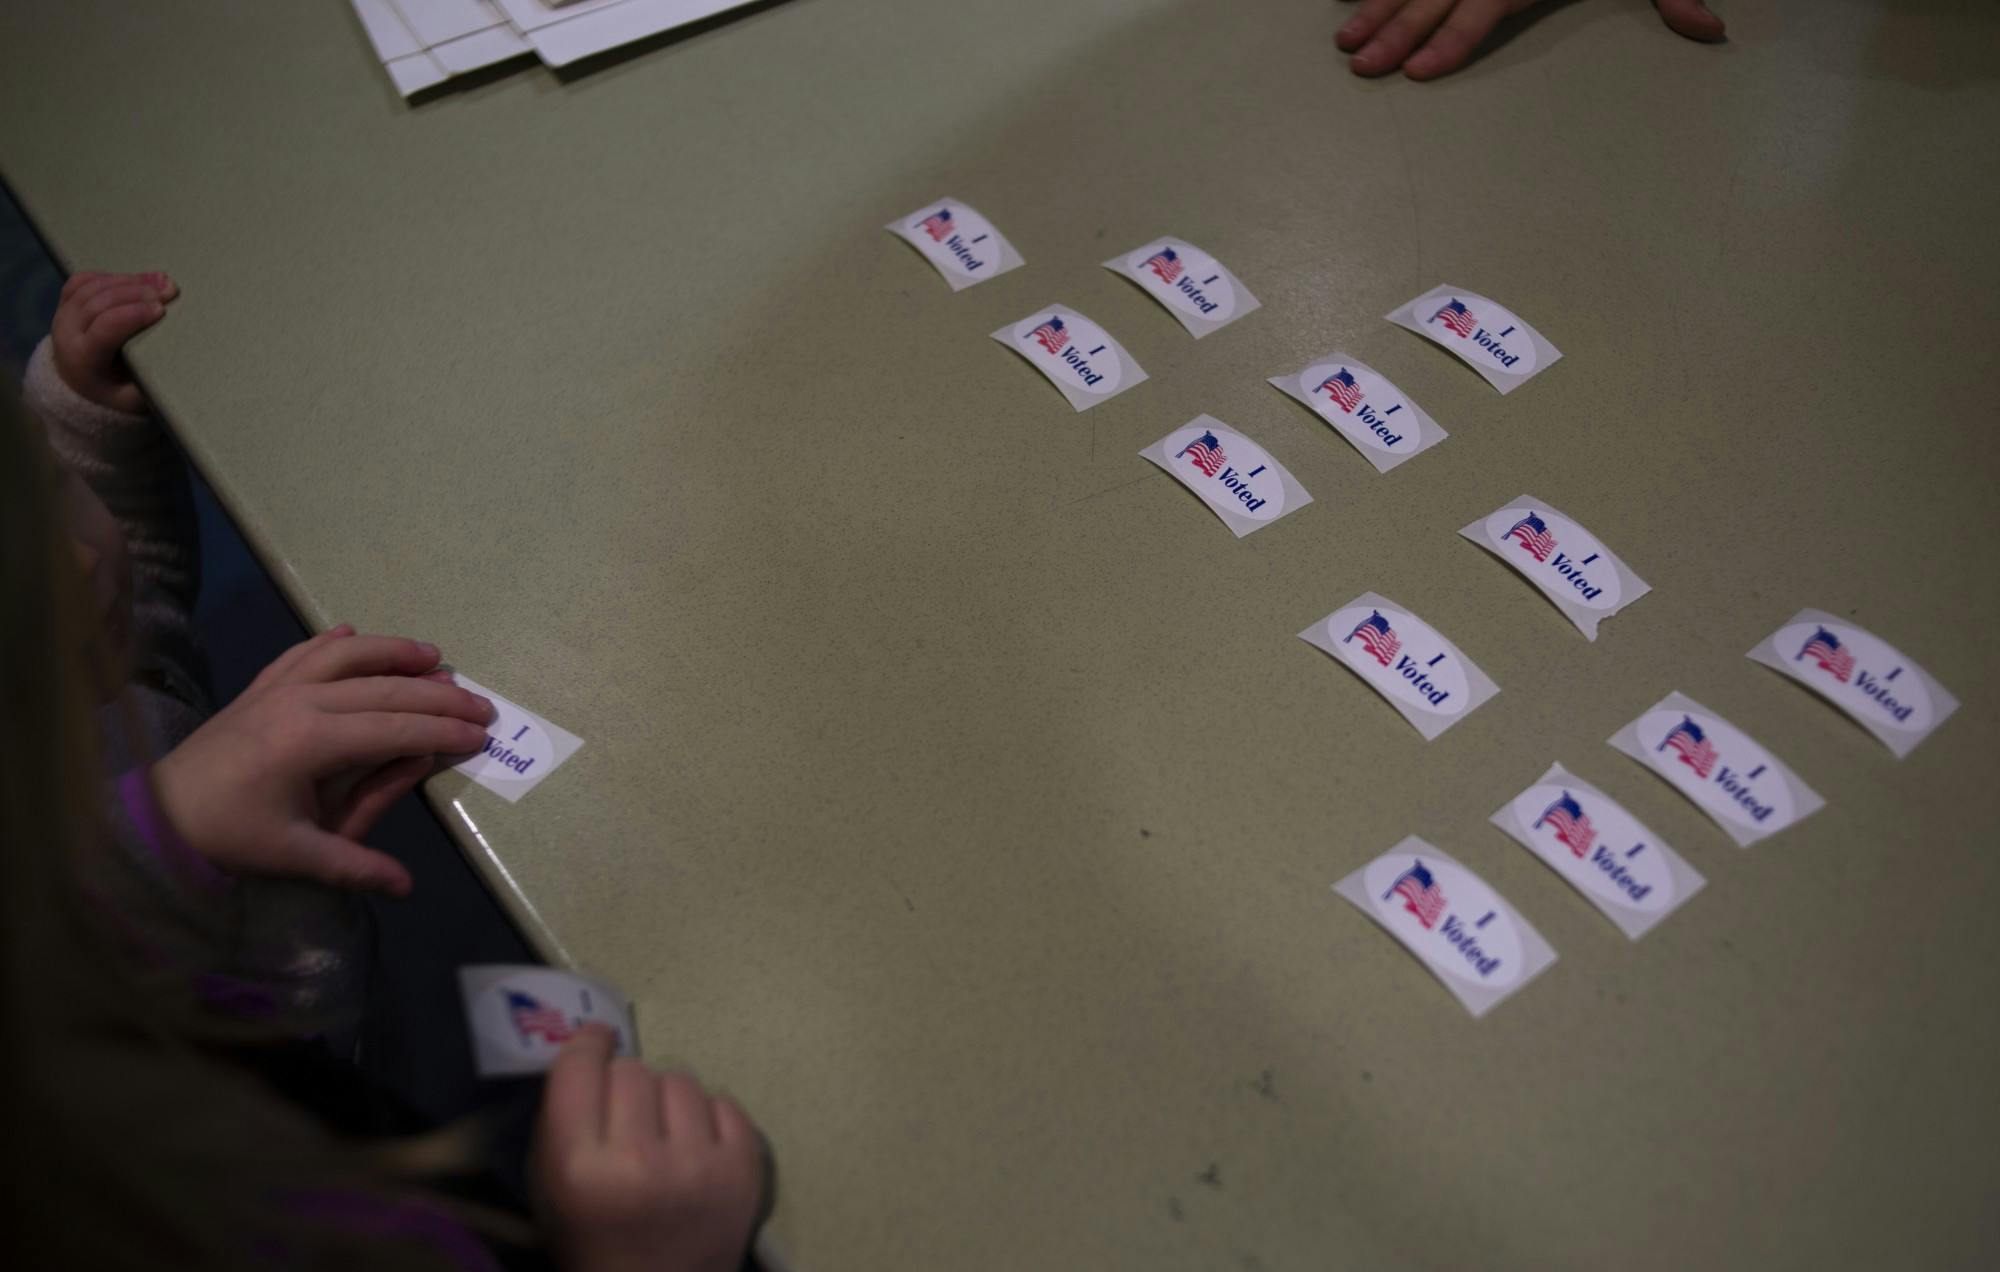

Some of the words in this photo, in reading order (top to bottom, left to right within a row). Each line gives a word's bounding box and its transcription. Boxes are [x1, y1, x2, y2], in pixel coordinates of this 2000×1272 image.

[946, 234, 984, 272] Voted
[971, 234, 988, 244] I
[1202, 274, 1219, 285] I
[1176, 275, 1219, 314] Voted
[1499, 325, 1516, 338] I
[1088, 345, 1106, 356] I
[1472, 328, 1520, 368] Voted
[1061, 345, 1104, 387] Voted
[1385, 404, 1403, 416] I
[1356, 404, 1403, 447] Voted
[1248, 465, 1267, 478] I
[1218, 466, 1266, 513] Voted
[1581, 553, 1599, 566] I
[1551, 552, 1603, 600] Voted
[1427, 653, 1446, 667] I
[1395, 655, 1449, 706] Voted
[1885, 667, 1903, 682] I
[1854, 670, 1914, 722] Voted
[512, 725, 530, 741] I
[483, 736, 535, 774] Voted
[1747, 765, 1767, 780] I
[1715, 767, 1774, 822] Voted
[1625, 843, 1645, 859] I
[1591, 845, 1652, 902] Voted
[1475, 911, 1496, 929] I
[1439, 914, 1500, 977] Voted
